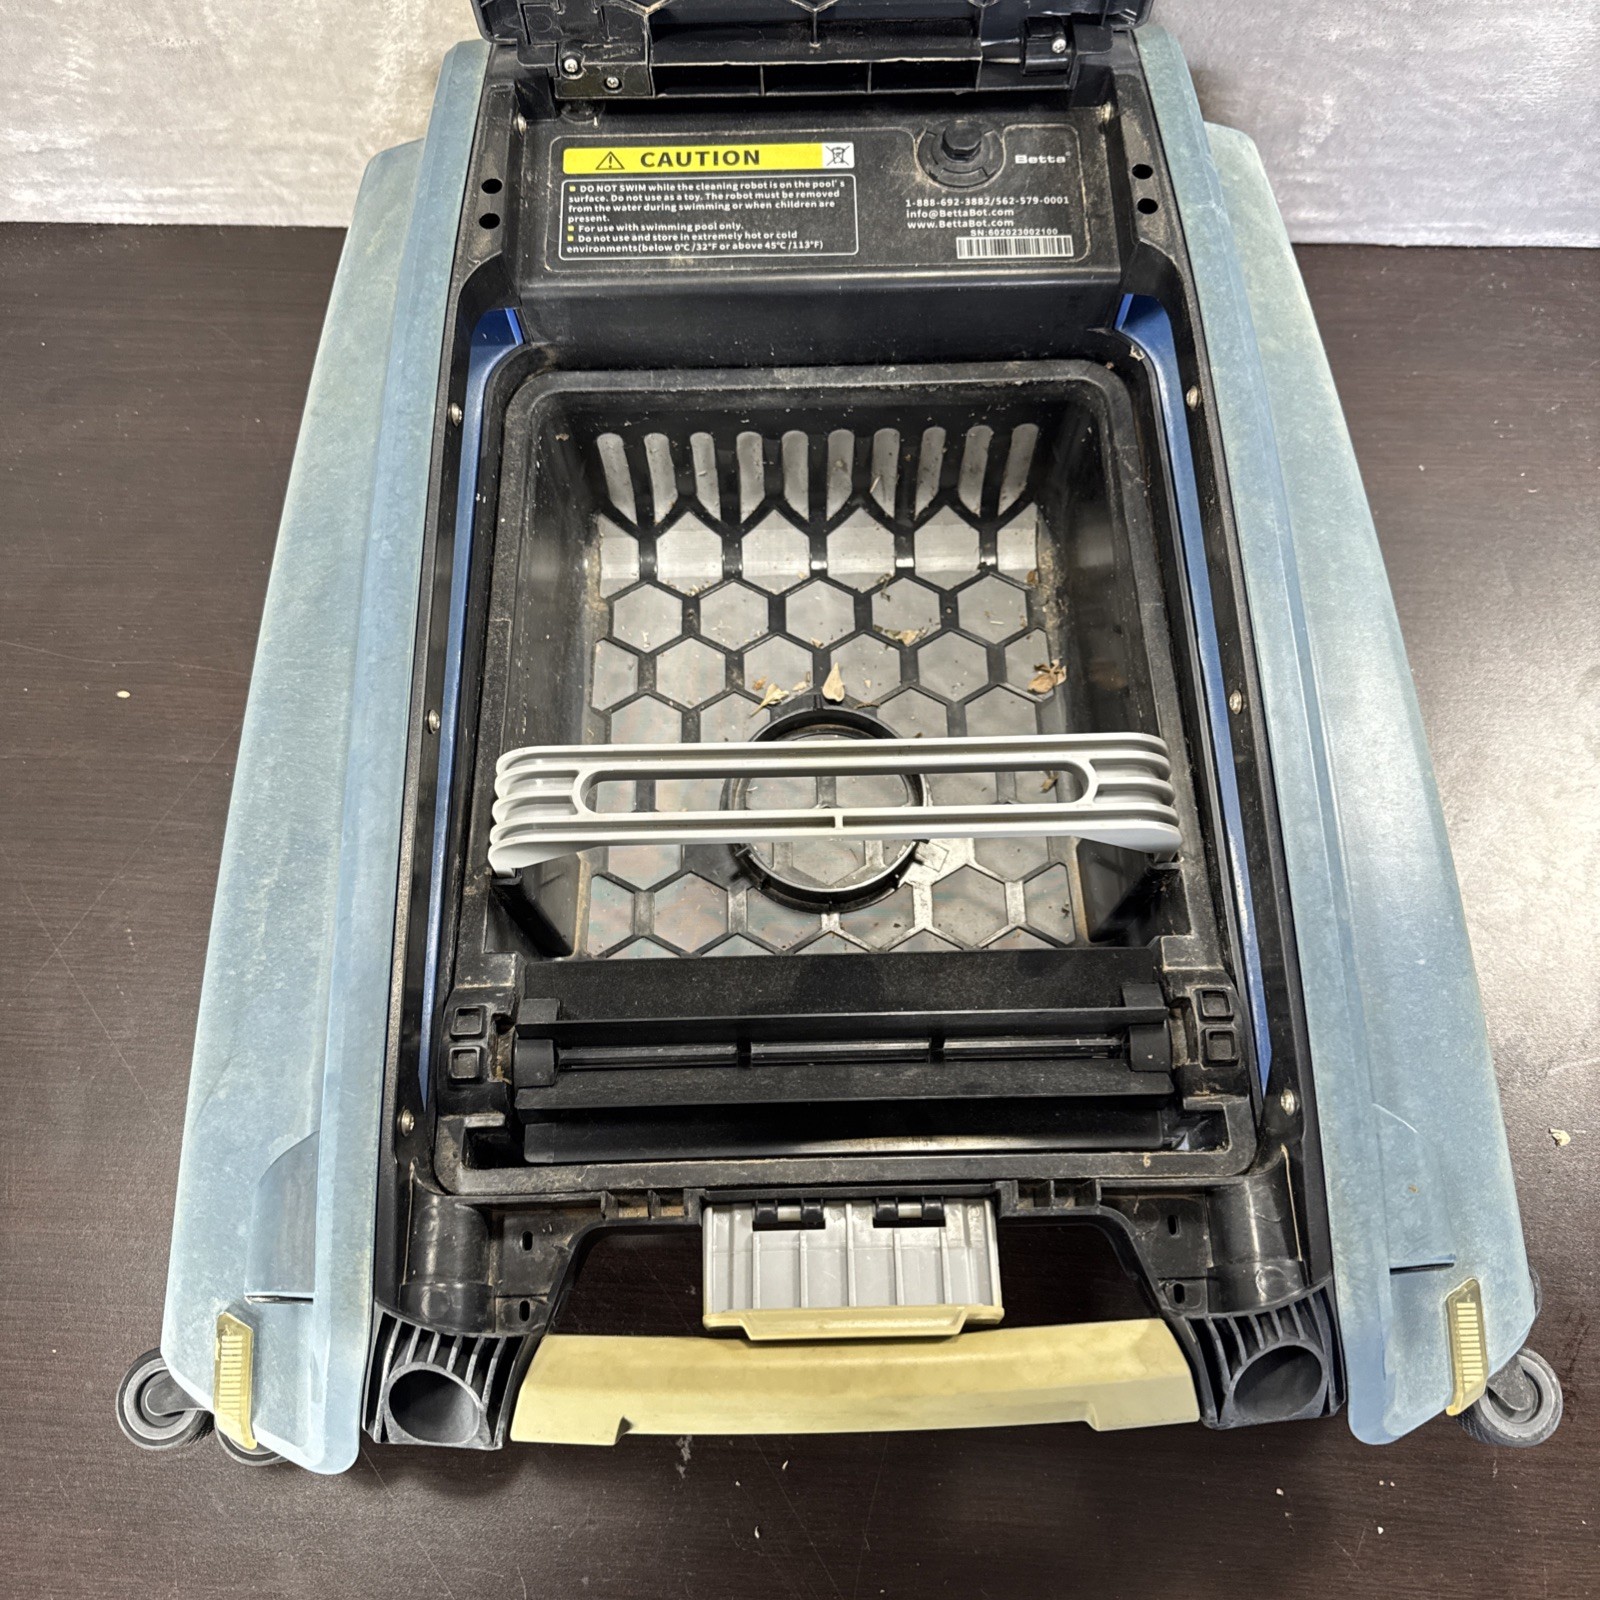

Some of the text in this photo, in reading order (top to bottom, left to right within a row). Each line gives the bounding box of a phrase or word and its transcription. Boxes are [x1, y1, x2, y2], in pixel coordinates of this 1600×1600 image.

[640, 150, 760, 168] CAUTION
[649, 183, 675, 191] while
[678, 183, 694, 191] the
[696, 182, 738, 191] cleaning
[741, 181, 767, 189] robot
[794, 180, 810, 188] the
[569, 195, 608, 203] surface.
[611, 194, 624, 202] Do
[684, 193, 703, 202] toy.
[796, 190, 839, 198] removed
[568, 205, 592, 213] from
[595, 204, 610, 212] the
[644, 203, 677, 212] during
[679, 202, 730, 211] swimming
[745, 201, 772, 209] when
[906, 209, 1014, 219] info@BettaBot.com
[568, 215, 610, 224] present.
[907, 219, 1014, 229] www.BettaBot.com
[616, 223, 639, 231] with
[641, 223, 693, 232] swimming
[695, 223, 717, 231] pool
[719, 222, 744, 231] only.
[680, 233, 689, 241] in
[692, 232, 742, 240] extremely
[745, 231, 761, 239] hot
[567, 244, 672, 253] environments(below
